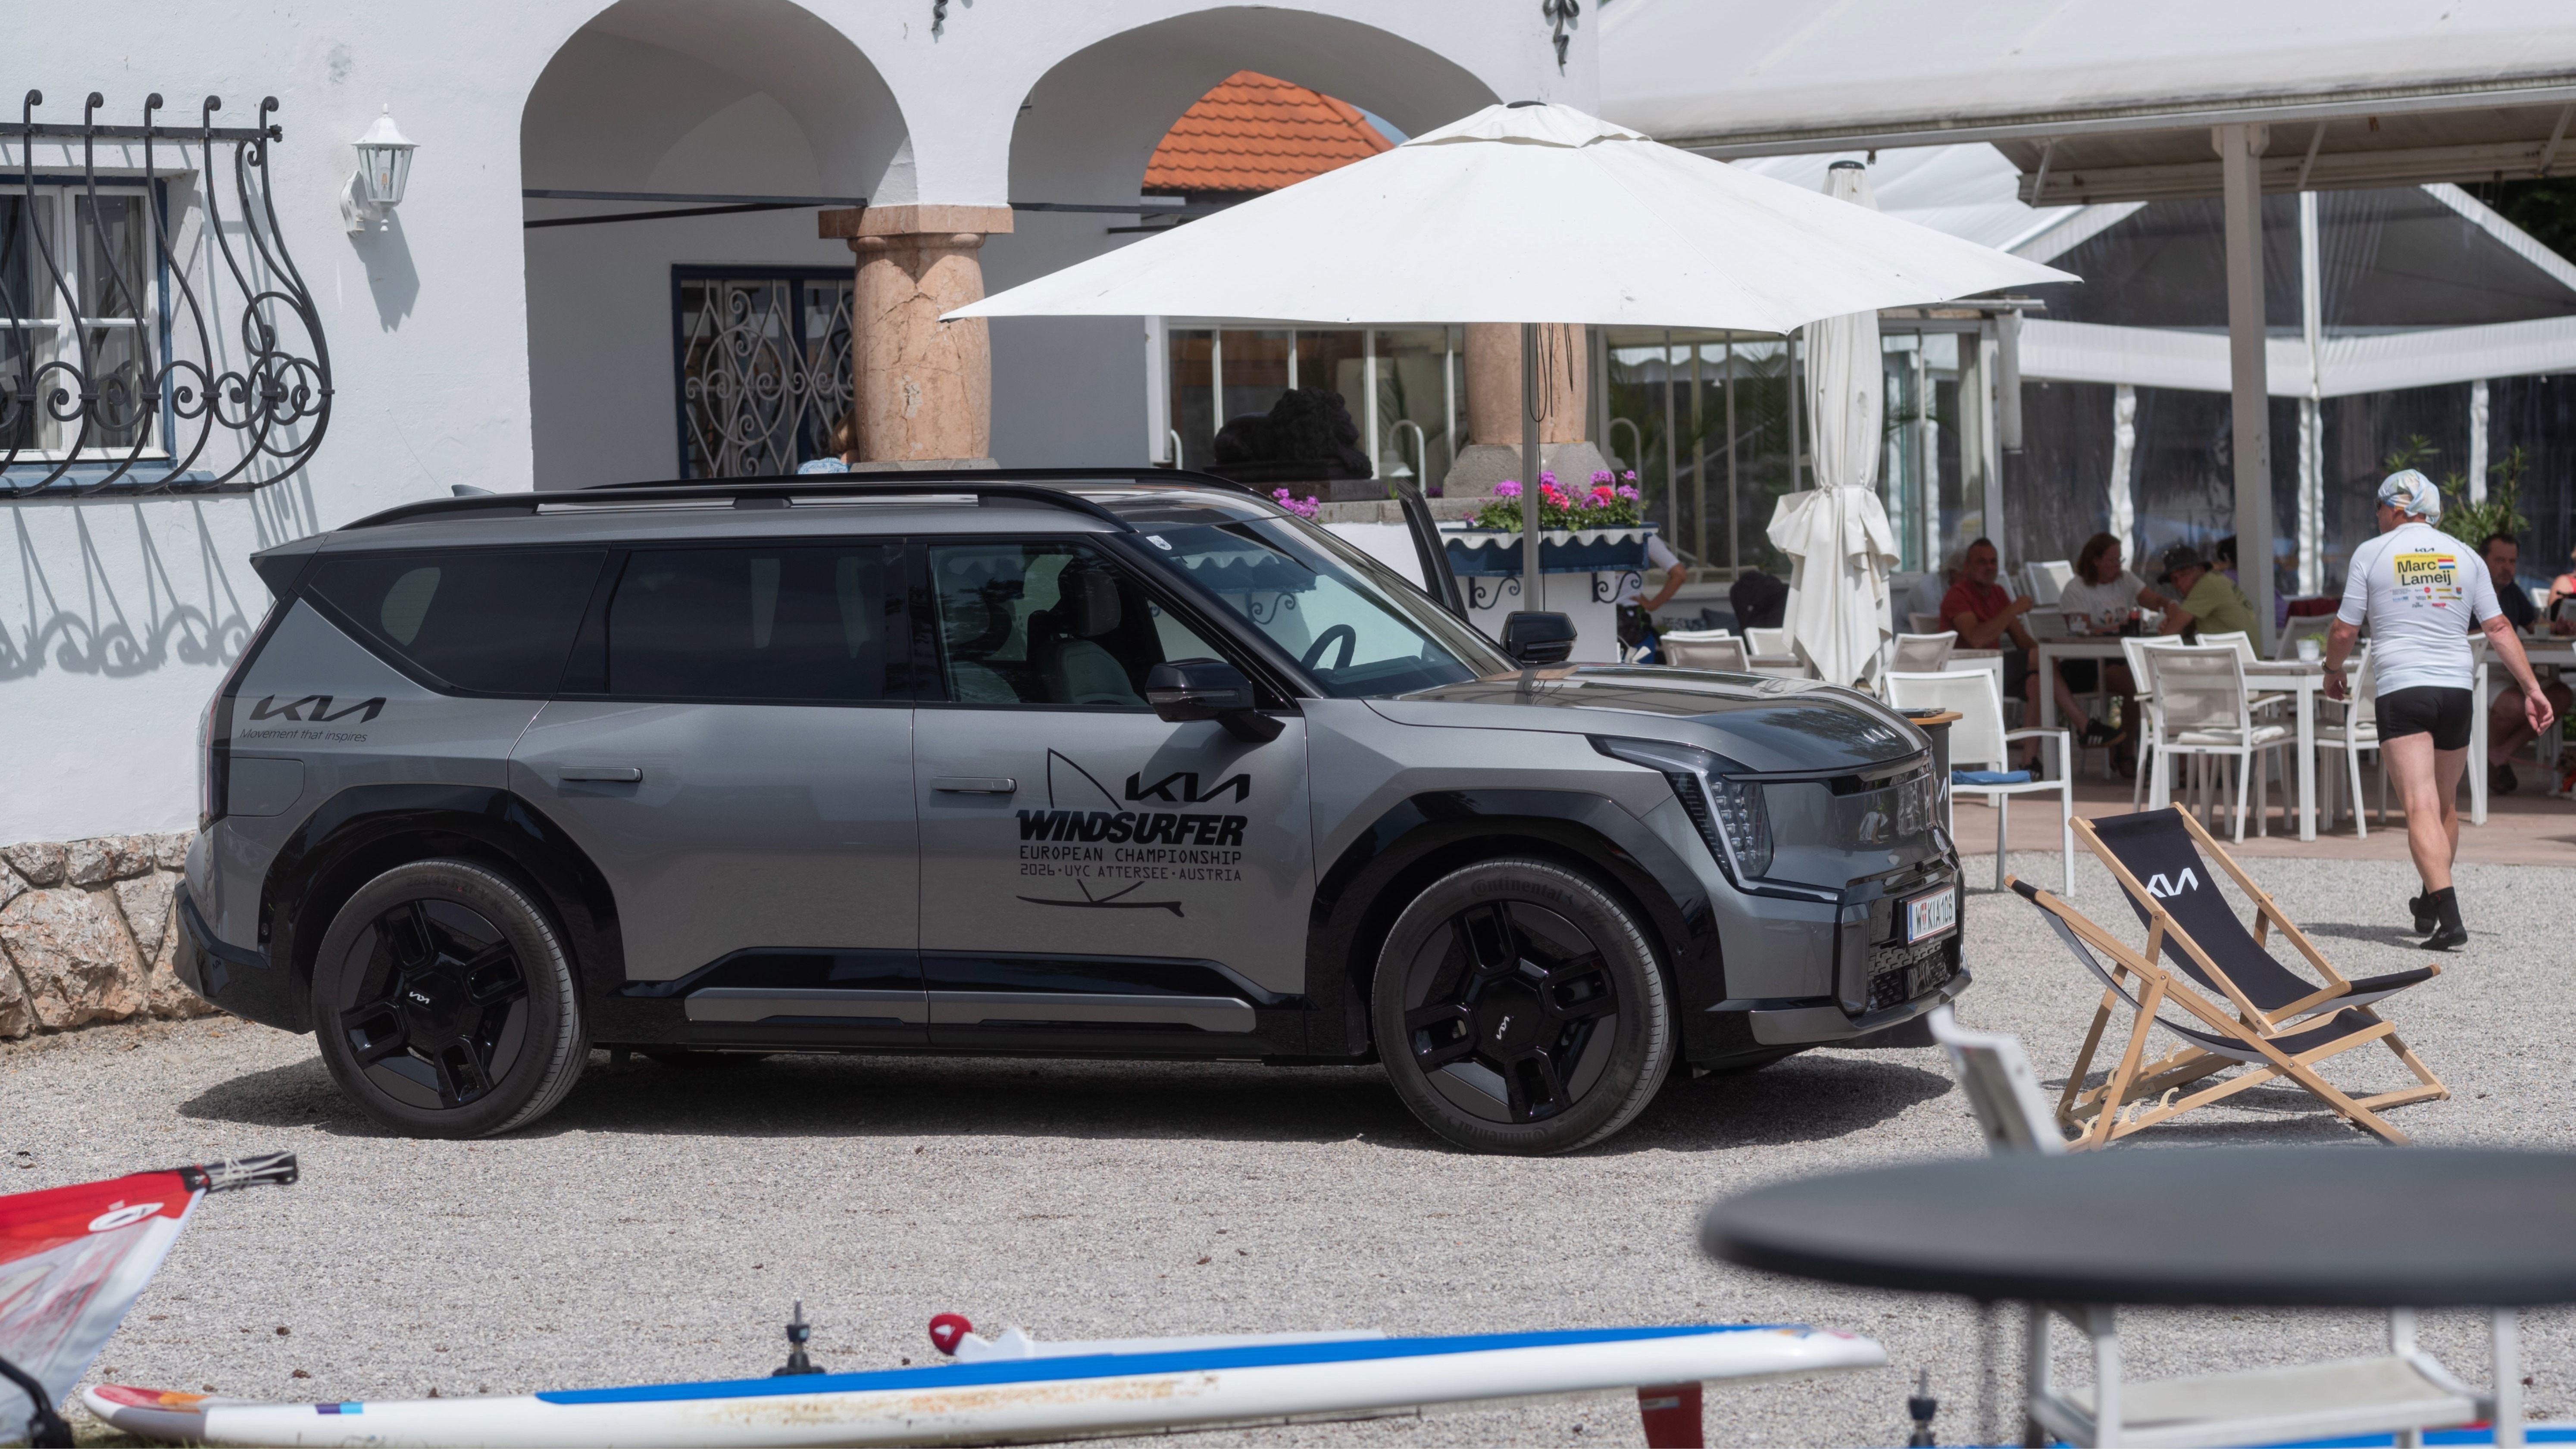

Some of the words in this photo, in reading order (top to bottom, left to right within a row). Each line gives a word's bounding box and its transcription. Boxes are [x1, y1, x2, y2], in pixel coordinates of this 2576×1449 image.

[2397, 560, 2436, 573] Marc
[2401, 570, 2451, 586] Lameij
[250, 694, 387, 724] KIA
[240, 728, 298, 739] Movement
[300, 729, 322, 740] that
[325, 730, 368, 743] inspires
[1125, 771, 1251, 804] KIA
[1015, 809, 1248, 846] WINDSURFER
[1020, 846, 1103, 862] EUROPEAN
[1115, 848, 1241, 865] CHAMPIONSHIP
[1471, 876, 1563, 902] Continental
[1916, 904, 1921, 934] W
[409, 991, 430, 1004] KIA
[1496, 1016, 1510, 1040] KIA
